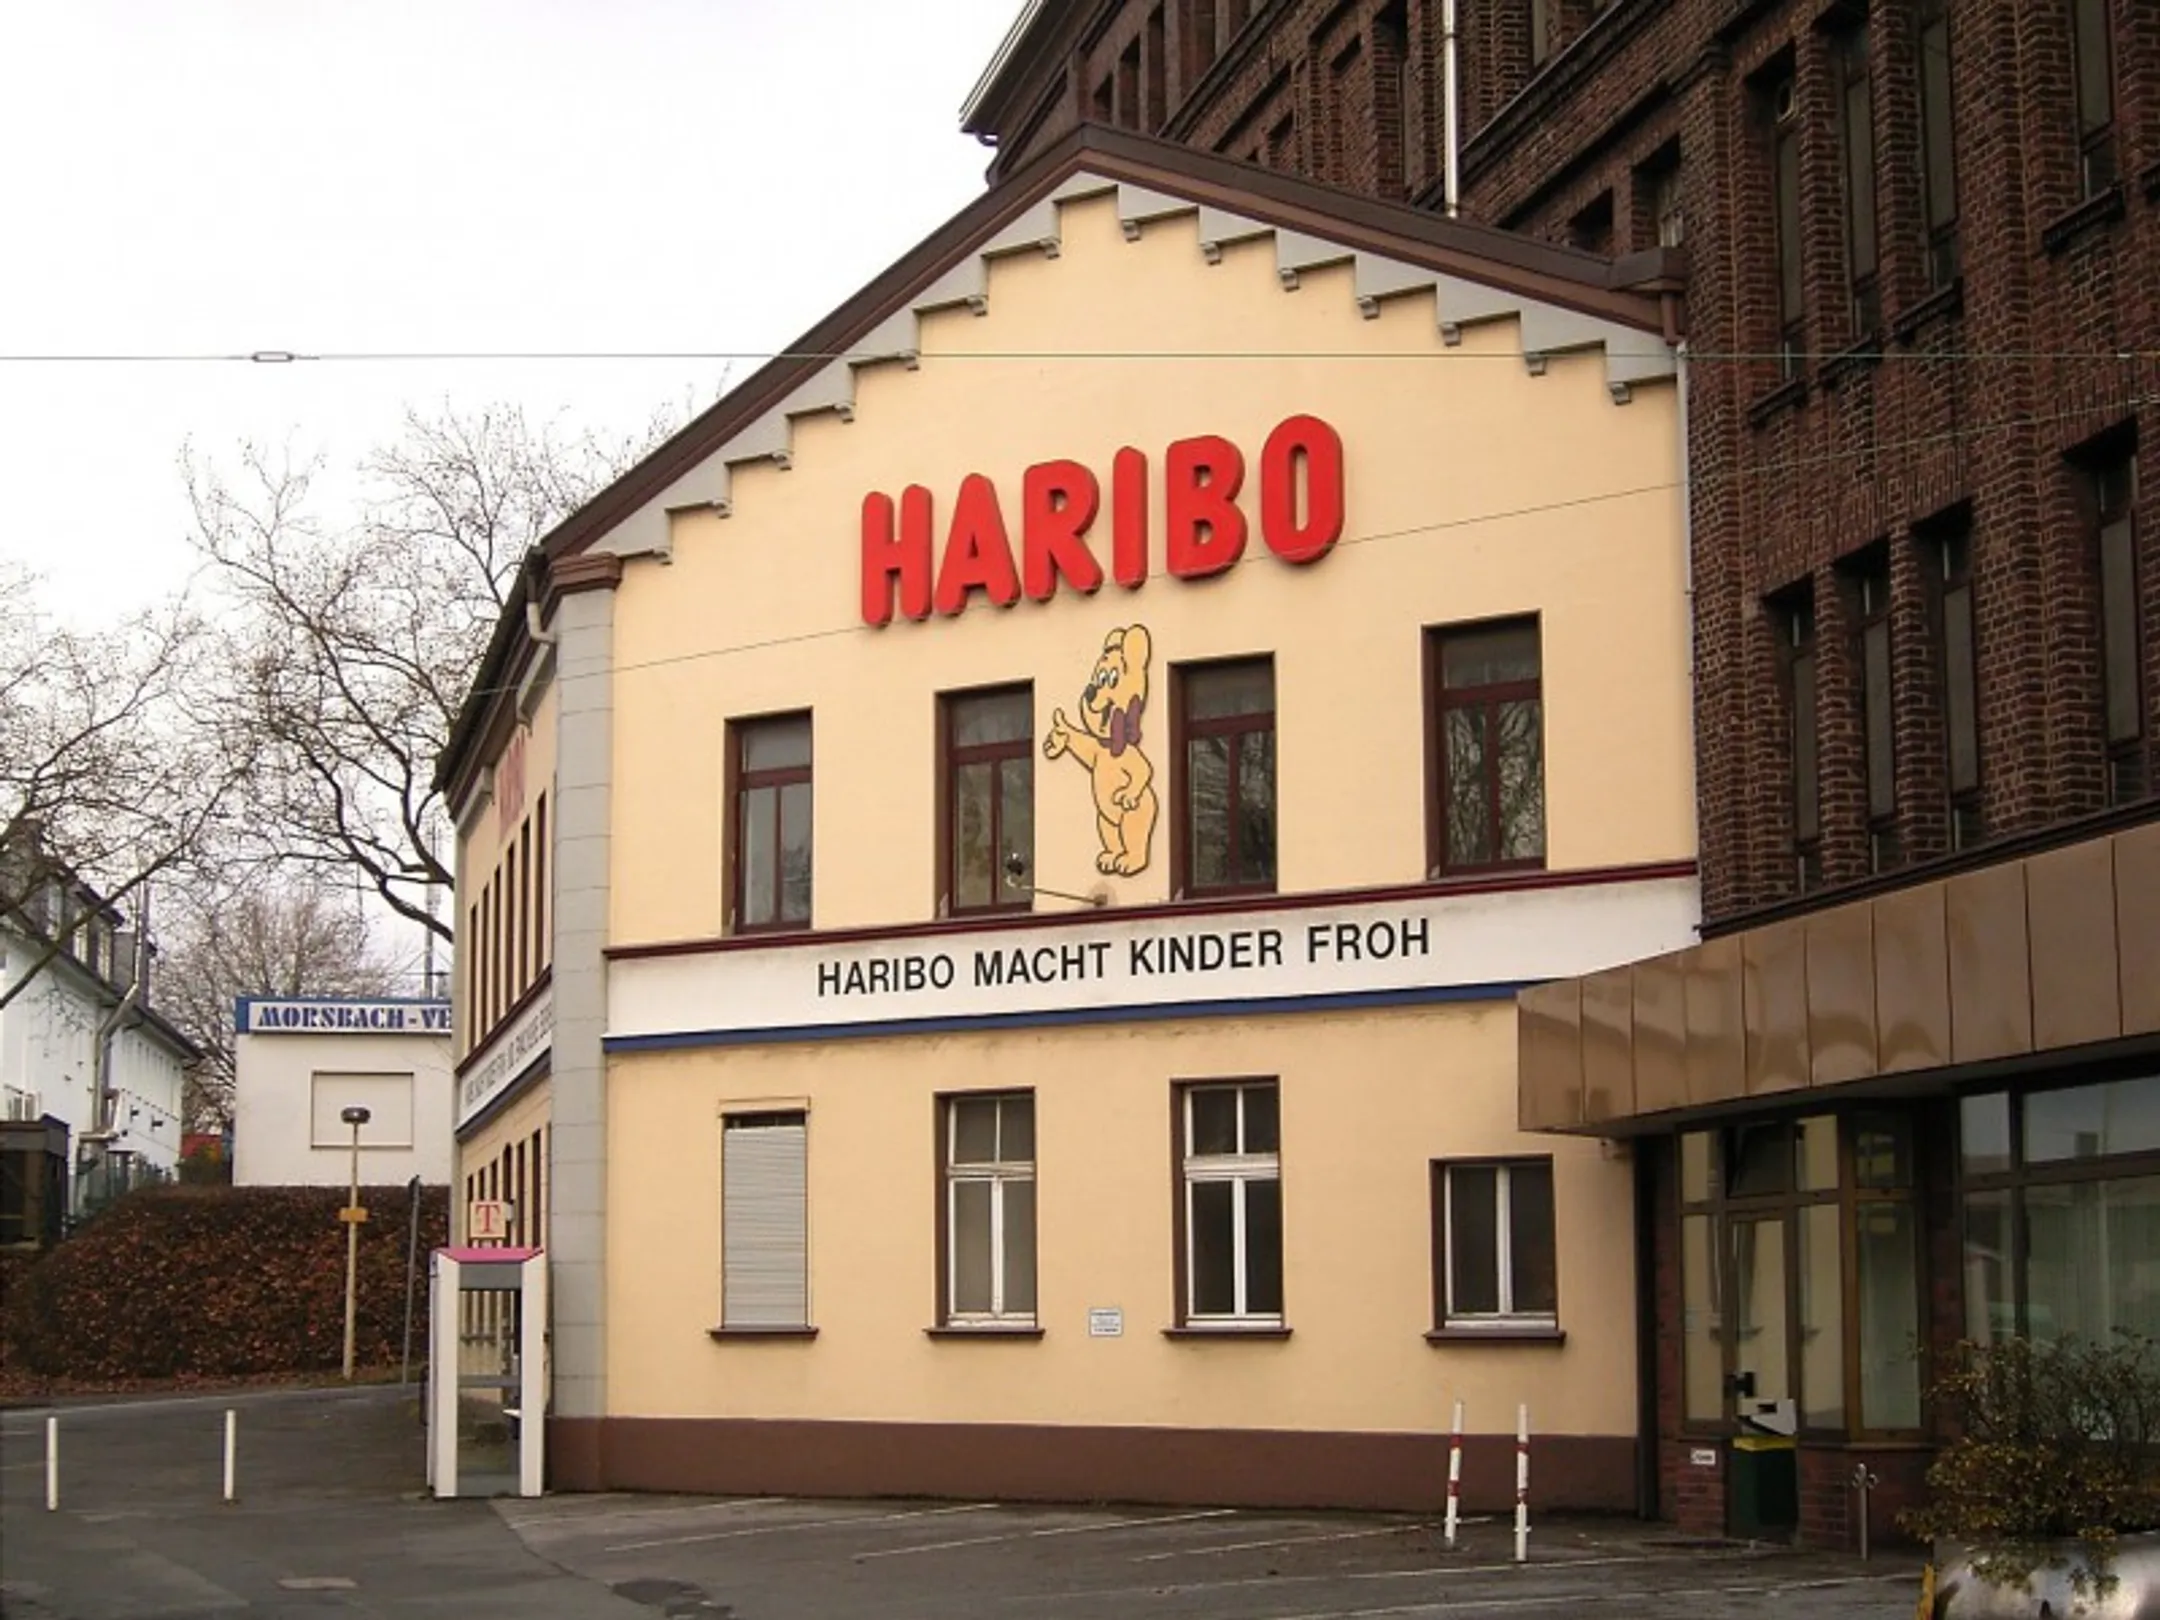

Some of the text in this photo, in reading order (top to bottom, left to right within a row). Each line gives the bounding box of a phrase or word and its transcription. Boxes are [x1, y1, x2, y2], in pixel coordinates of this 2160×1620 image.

[862, 413, 1344, 630] HARIBO
[818, 917, 1429, 998] HARIBO MACHT KINDER FROH
[475, 1204, 500, 1234] T
